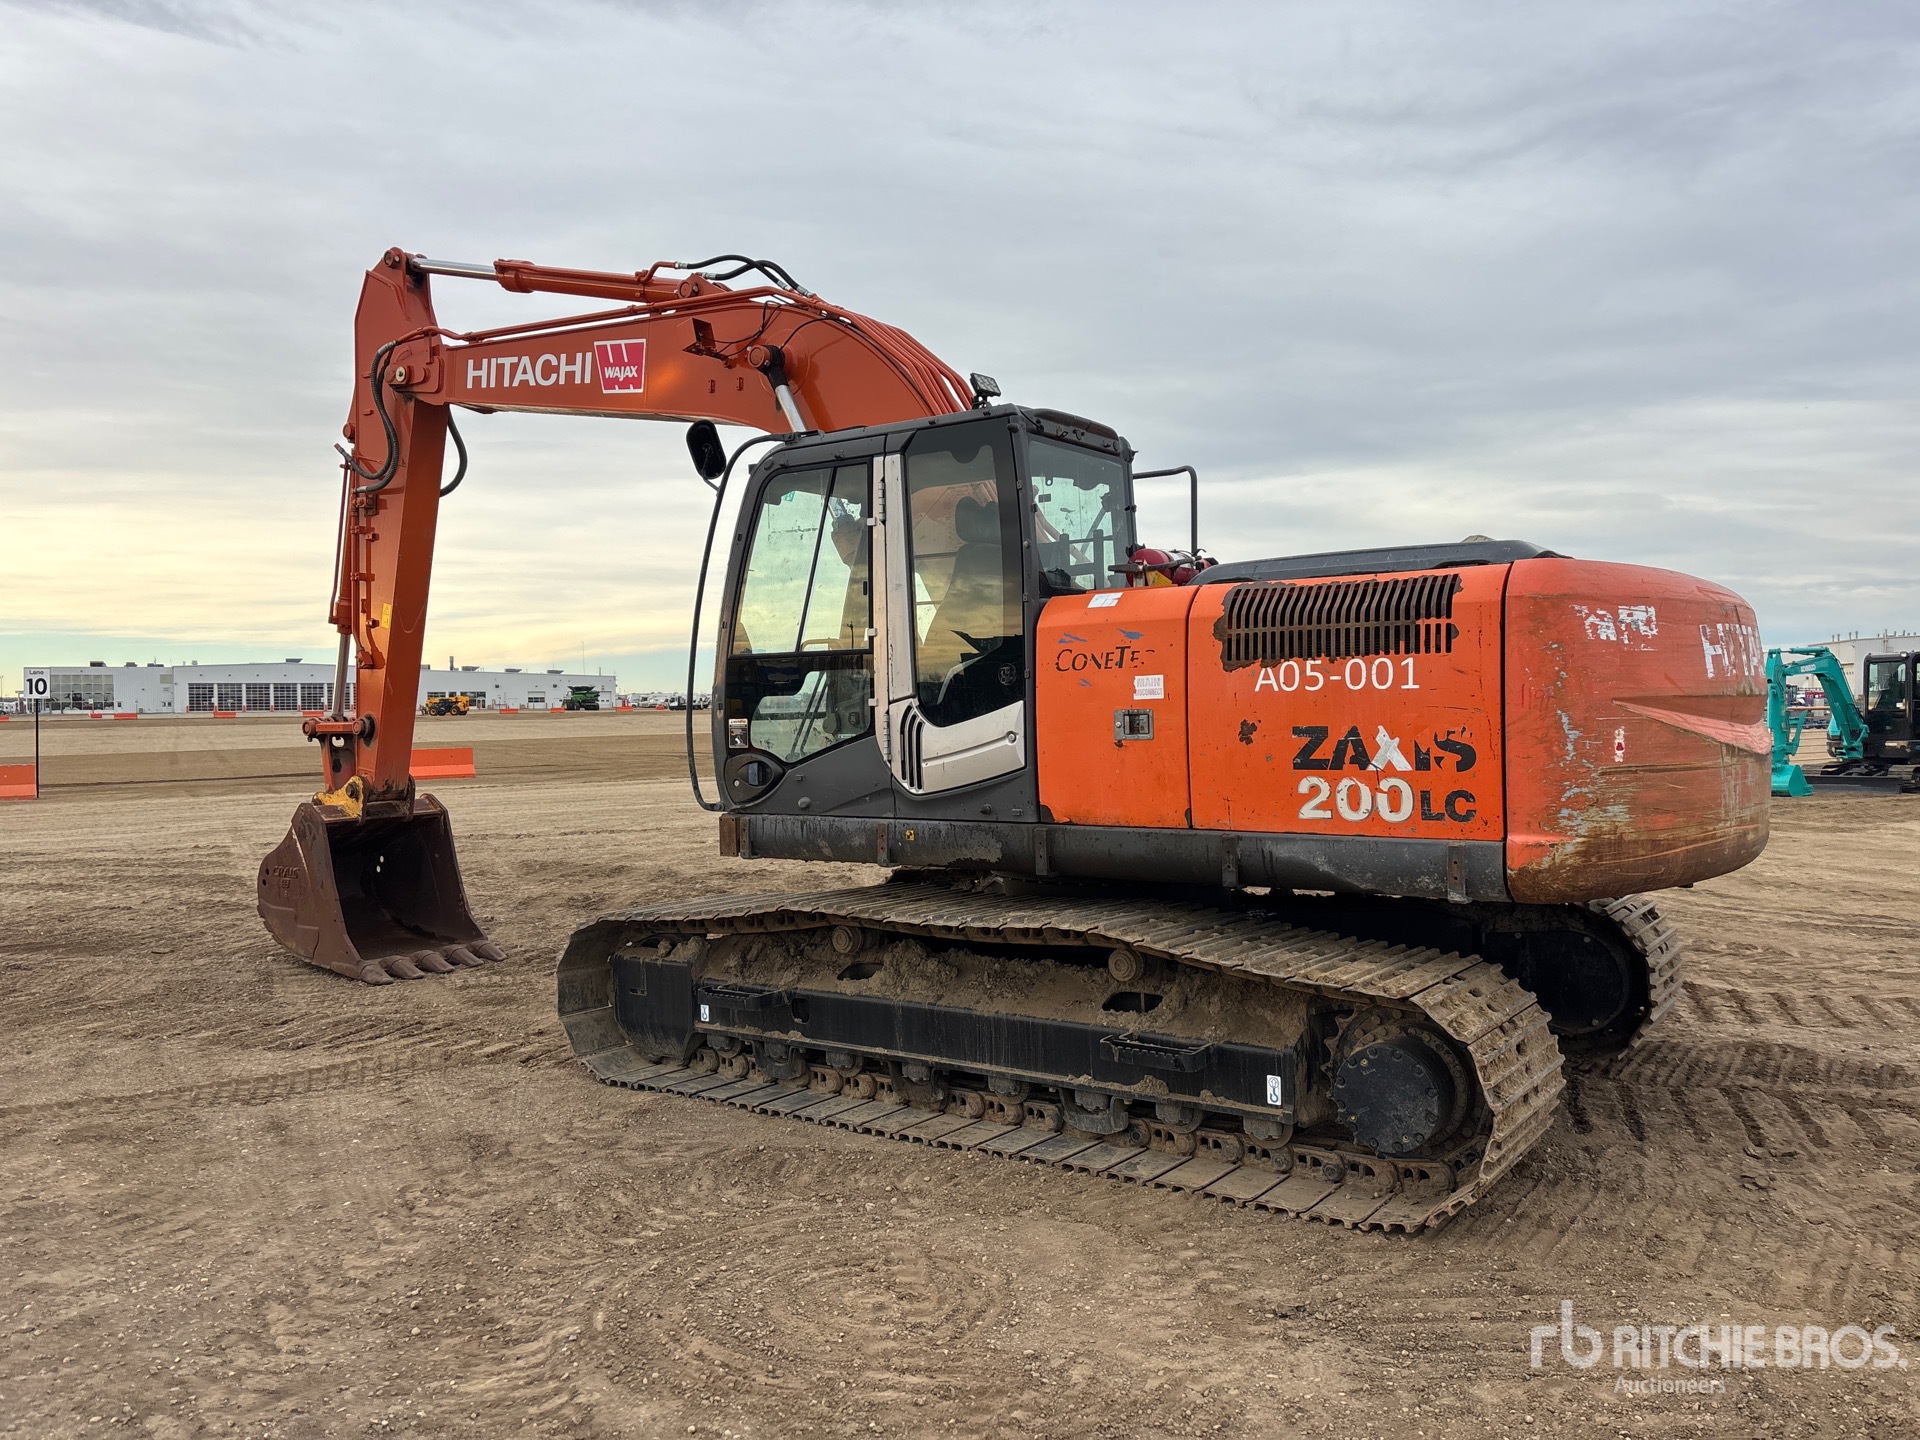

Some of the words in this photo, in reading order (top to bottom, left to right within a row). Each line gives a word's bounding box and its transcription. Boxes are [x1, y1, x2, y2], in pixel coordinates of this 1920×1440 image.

[466, 352, 592, 389] HITACHI
[604, 365, 638, 382] WAJAX
[26, 677, 48, 695] 10
[1254, 656, 1420, 692] A05-001
[1297, 775, 1415, 823] 200
[1420, 789, 1477, 823] LC
